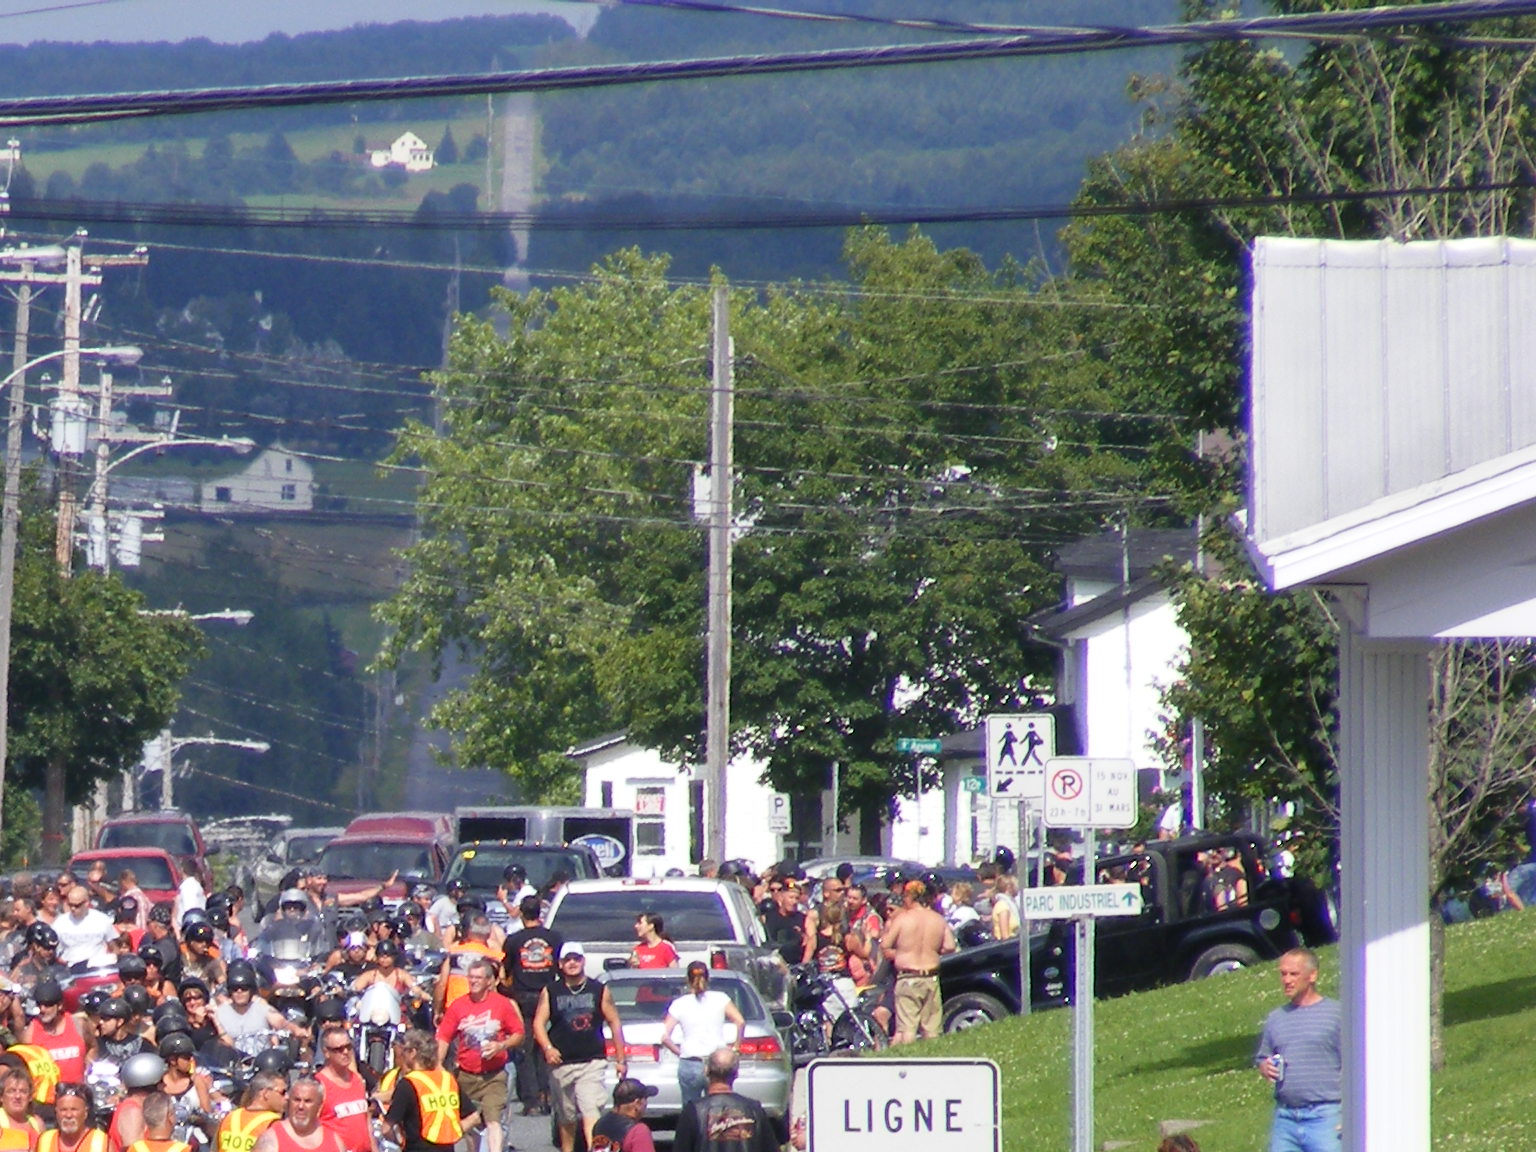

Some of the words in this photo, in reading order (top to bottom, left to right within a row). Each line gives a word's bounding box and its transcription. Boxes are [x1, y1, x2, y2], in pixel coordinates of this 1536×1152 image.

[1025, 895, 1054, 912] PARC
[1059, 892, 1120, 910] INDUSTRIEL
[429, 1095, 458, 1108] HOG
[844, 1098, 963, 1133] LIGNE
[223, 1135, 254, 1151] HOG
